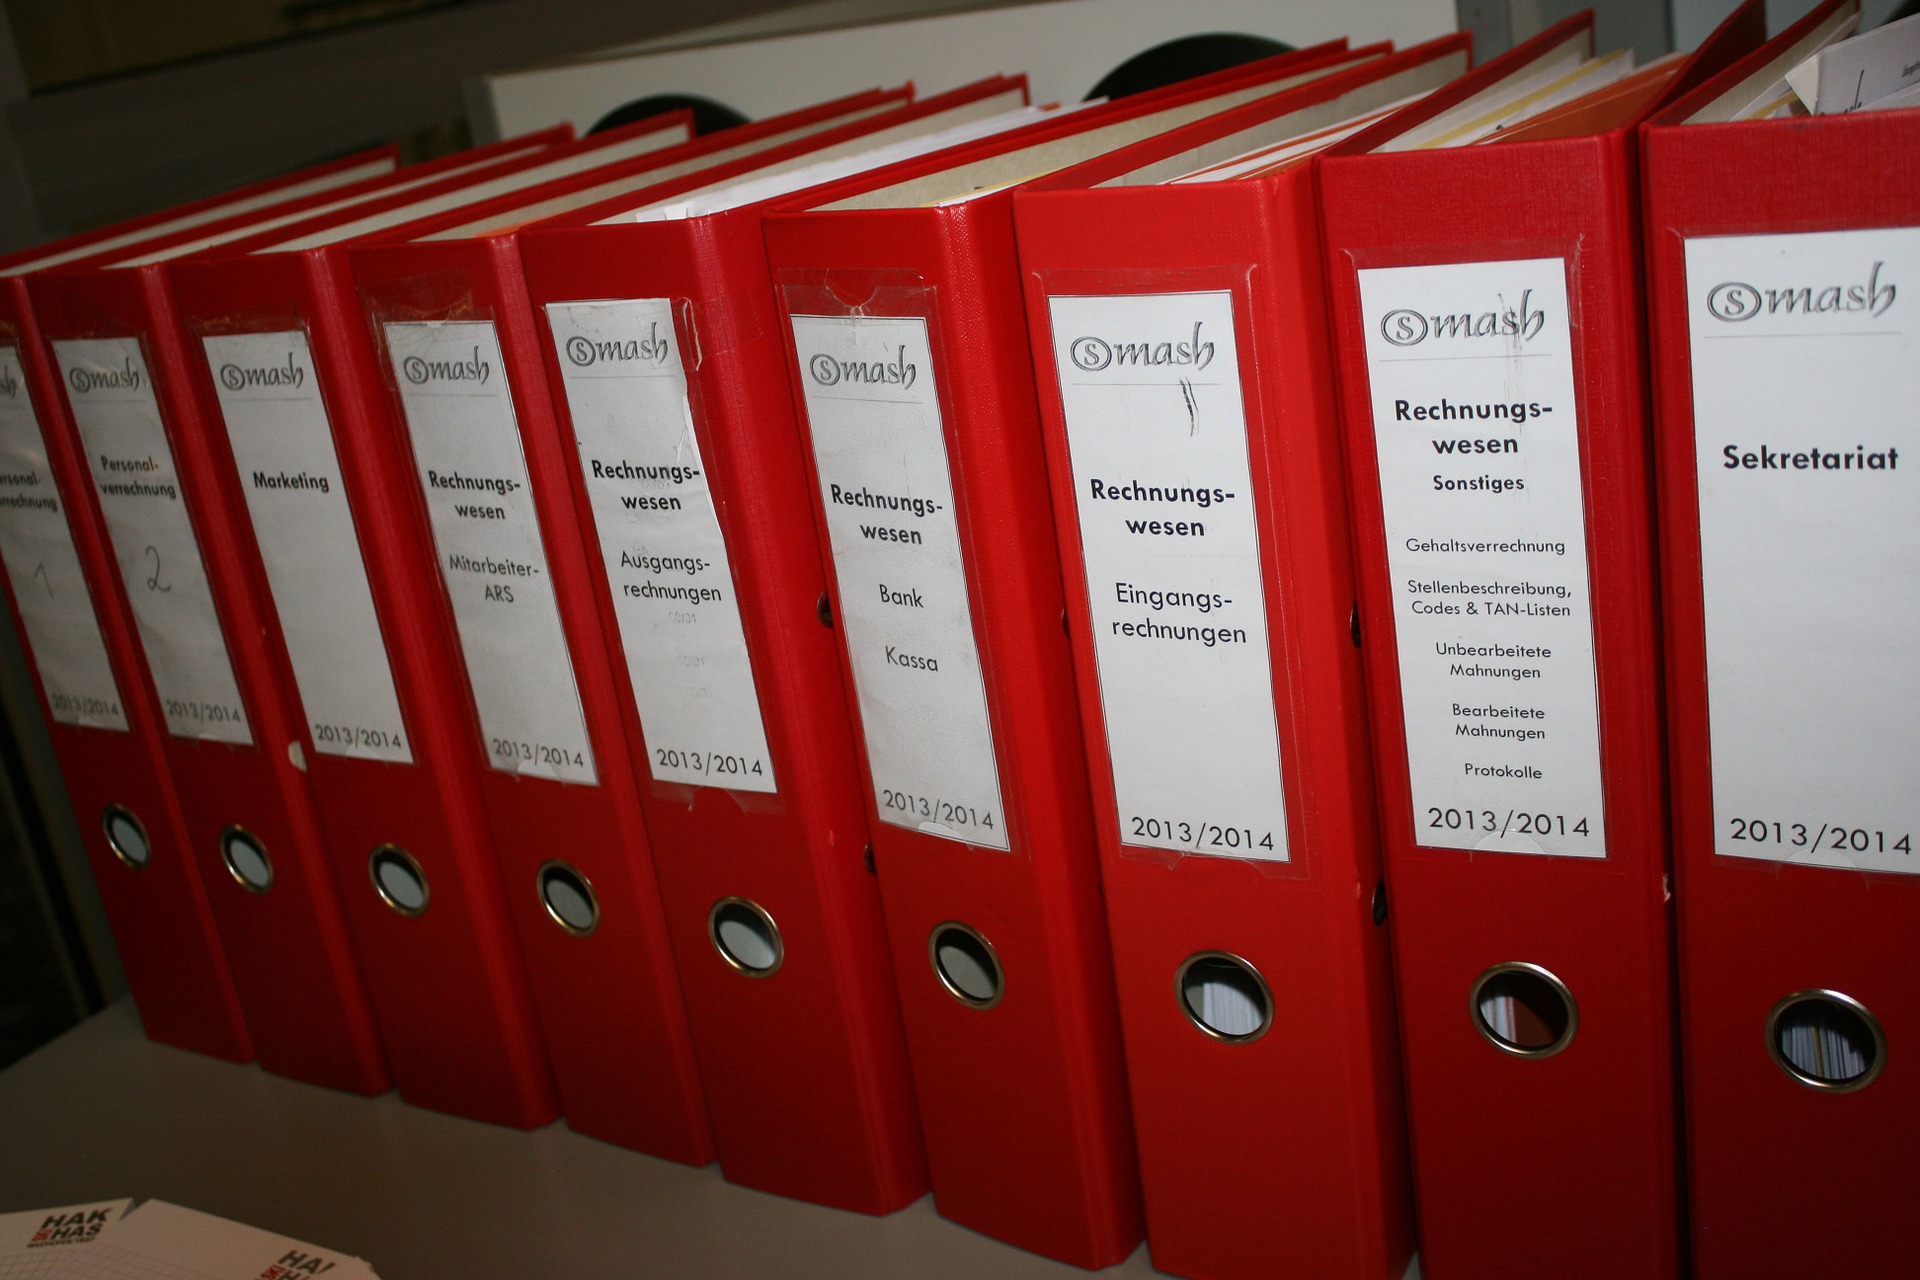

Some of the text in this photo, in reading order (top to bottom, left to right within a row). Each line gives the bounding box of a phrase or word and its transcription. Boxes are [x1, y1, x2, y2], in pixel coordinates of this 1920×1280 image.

[1395, 399, 1552, 423] Rechnungs-
[1432, 439, 1518, 454] wesen
[1724, 445, 1898, 469] Sekretariat
[100, 455, 157, 472] Personal-
[591, 460, 700, 484] Rechnungs-
[100, 480, 176, 499] verrechnung
[253, 471, 329, 493] Marketing
[428, 470, 520, 495] Rechnungs-
[1433, 475, 1524, 493] Sonstiges
[621, 497, 681, 510] wesen
[831, 484, 942, 517] Rechnungs-
[1091, 479, 1235, 508] Rechnungs-
[455, 505, 505, 519] wesen
[860, 525, 922, 544] wesen
[1125, 520, 1204, 536] wesen
[1406, 538, 1565, 555] Gehaltsverrechnung
[145, 546, 171, 593] 2
[450, 554, 539, 576] Mitarbeiter-
[621, 550, 710, 575] Ausgangs-
[485, 584, 514, 603] ARS
[624, 580, 721, 605] rechnungen
[879, 584, 923, 608] Bank
[1116, 583, 1232, 613] Eingangs-
[1408, 580, 1571, 598] Stellenbeschreibung,
[1412, 601, 1570, 616] Codes & TAN-Listen
[1113, 618, 1246, 647] rechnungen
[886, 646, 938, 671] Kassa
[1436, 642, 1551, 657] Unbearbeitete
[1451, 664, 1540, 681] Mahnungen
[166, 699, 240, 721] 2013/2014
[1453, 703, 1545, 719] Bearbeitete
[316, 724, 401, 749] 2013/2014
[1456, 724, 1545, 741] Mahnungen
[493, 738, 583, 768] 2013/2014
[657, 749, 762, 776] 2013/2014
[1465, 763, 1542, 779] Protokolle
[883, 789, 993, 830] 2013/2014
[1132, 817, 1273, 850] 2013/2014
[1429, 808, 1589, 838] 2013/2014
[1731, 818, 1911, 855] 2013/2014
[41, 1207, 112, 1228] HAK
[50, 1223, 102, 1240] HAS
